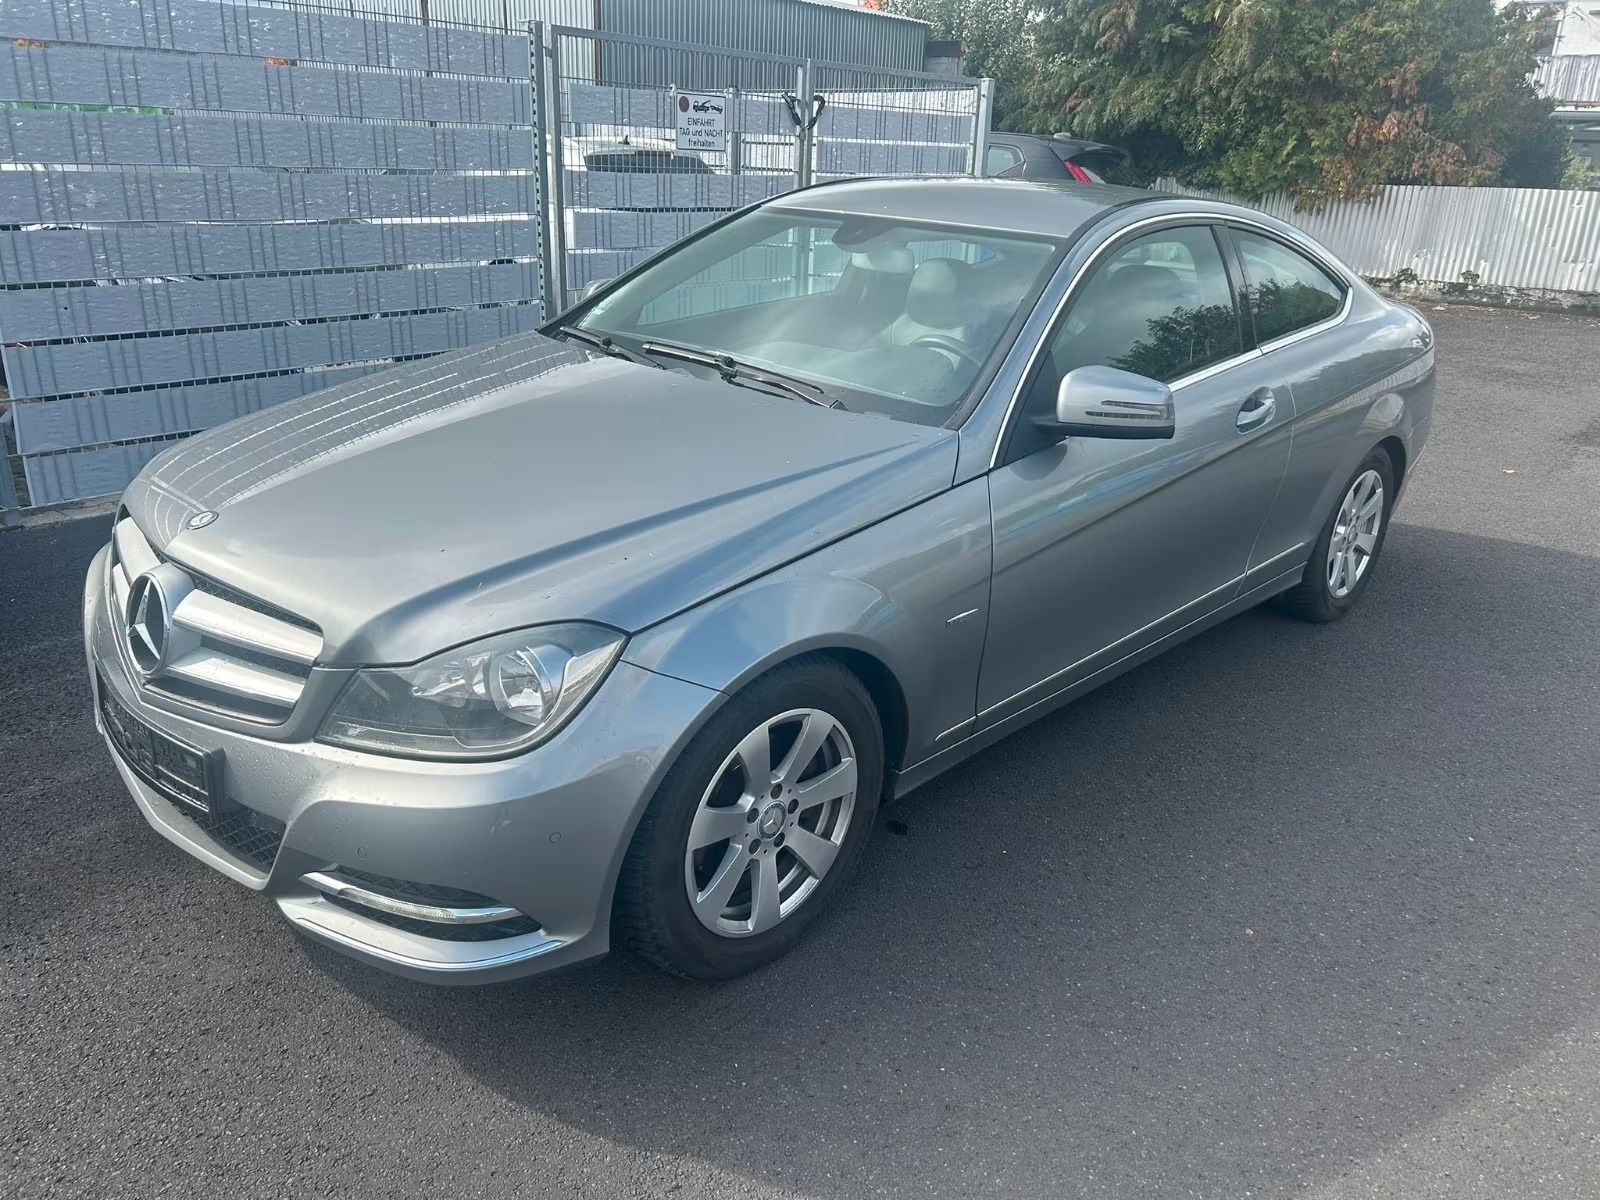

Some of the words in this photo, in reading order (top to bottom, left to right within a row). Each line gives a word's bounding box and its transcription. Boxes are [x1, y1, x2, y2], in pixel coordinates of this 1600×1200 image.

[687, 117, 715, 127] EINFAHRT
[679, 127, 690, 136] TAG
[691, 129, 703, 137] und
[704, 129, 723, 138] NACHT
[688, 138, 715, 147] freihalten
